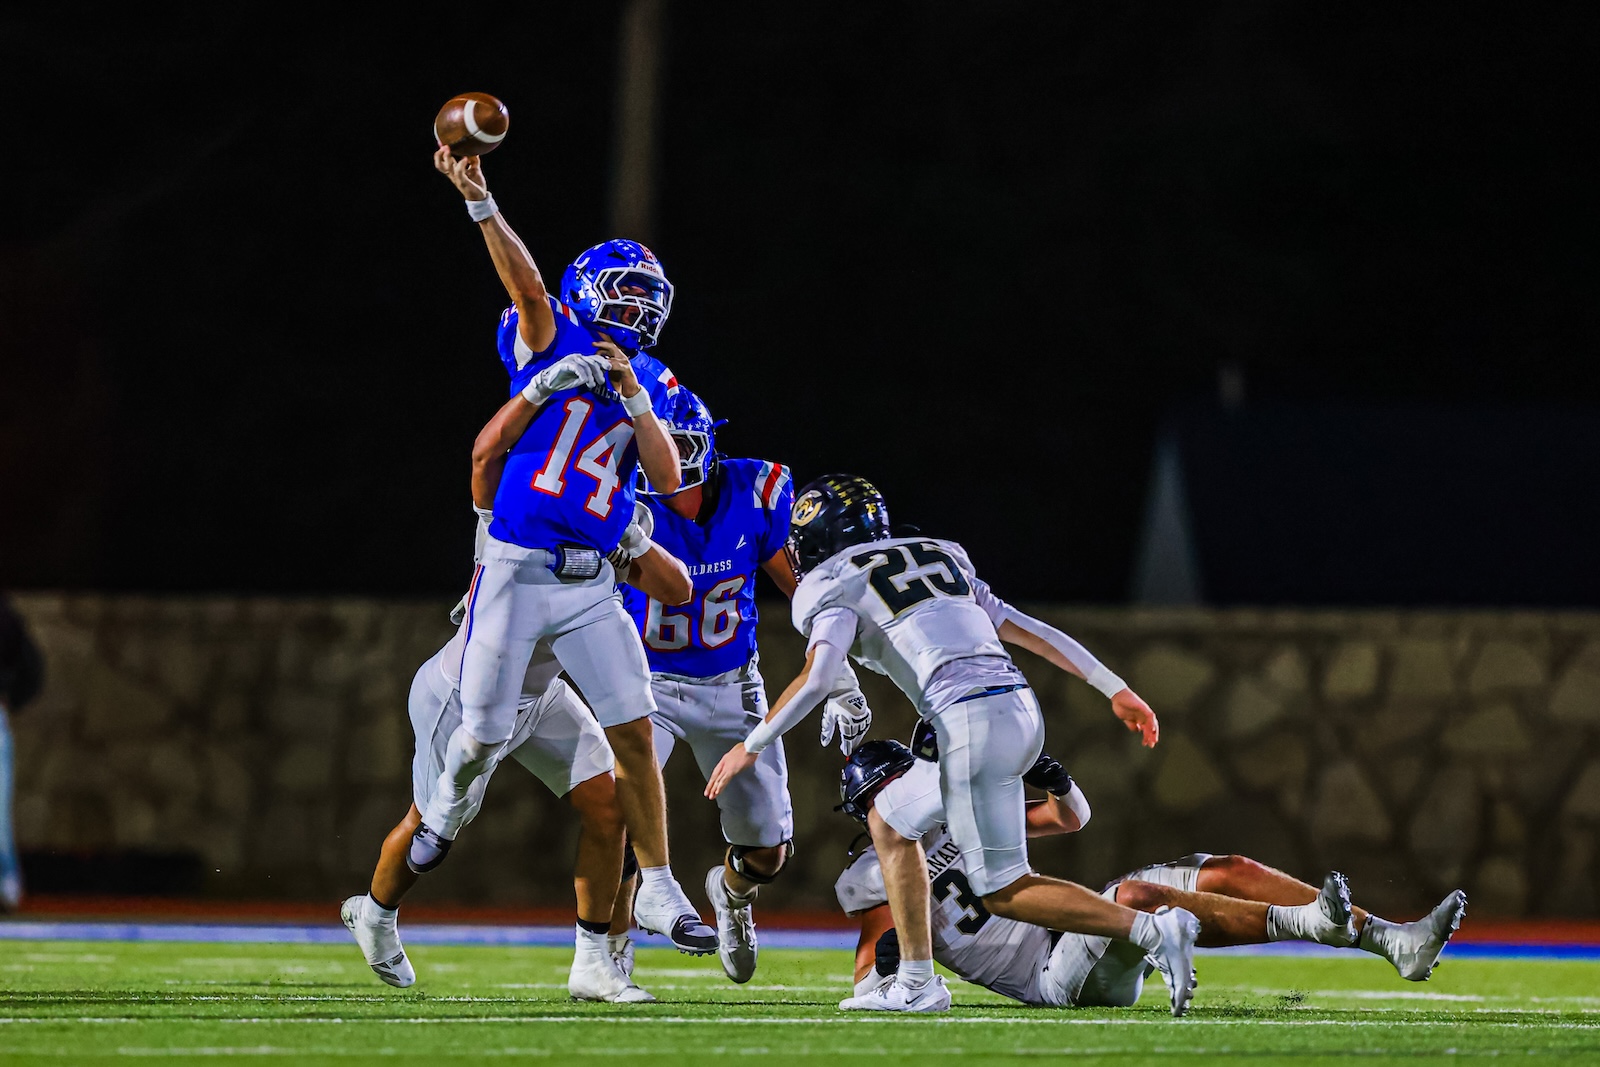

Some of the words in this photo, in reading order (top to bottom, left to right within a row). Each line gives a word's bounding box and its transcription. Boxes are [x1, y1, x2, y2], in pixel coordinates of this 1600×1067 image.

[530, 396, 634, 521] 14
[688, 560, 732, 576] ILDRESS
[851, 542, 971, 620] 25
[642, 573, 746, 652] 66
[927, 841, 960, 880] ANAD
[931, 868, 991, 936] 3
